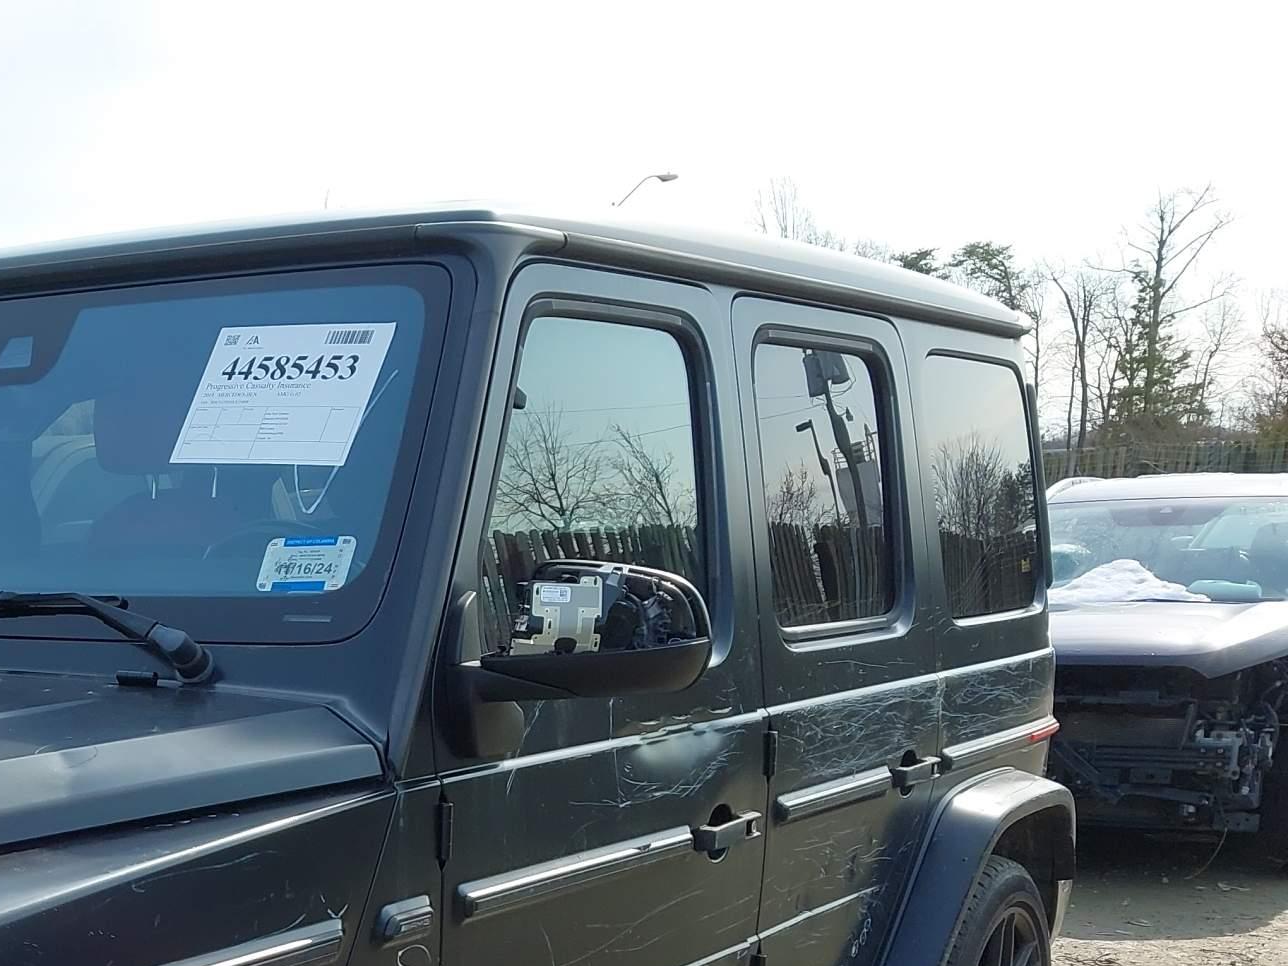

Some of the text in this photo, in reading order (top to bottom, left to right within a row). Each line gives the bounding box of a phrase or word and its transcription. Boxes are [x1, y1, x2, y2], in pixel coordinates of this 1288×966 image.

[222, 355, 360, 381] 44585453
[206, 381, 312, 392] Progressive Casualty Insurance
